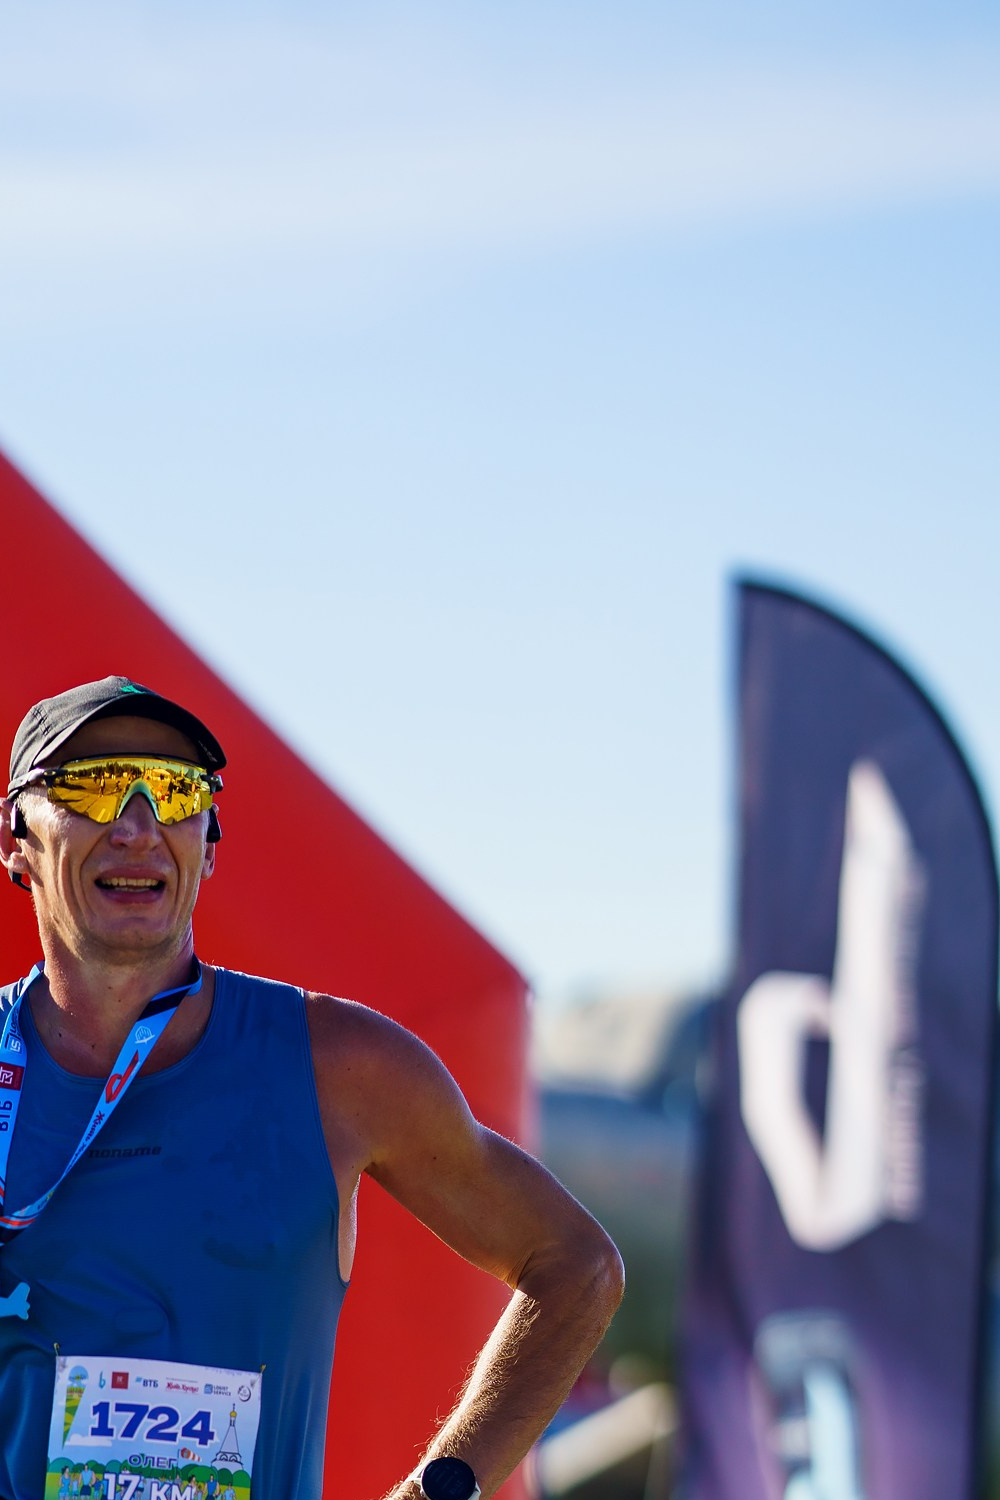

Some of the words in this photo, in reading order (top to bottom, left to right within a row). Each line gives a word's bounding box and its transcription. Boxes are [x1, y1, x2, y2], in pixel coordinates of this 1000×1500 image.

[88, 1146, 162, 1159] noname
[143, 1379, 159, 1388] ВТБ
[90, 1401, 215, 1446] 1724
[128, 1454, 178, 1469] ОЛЕГ
